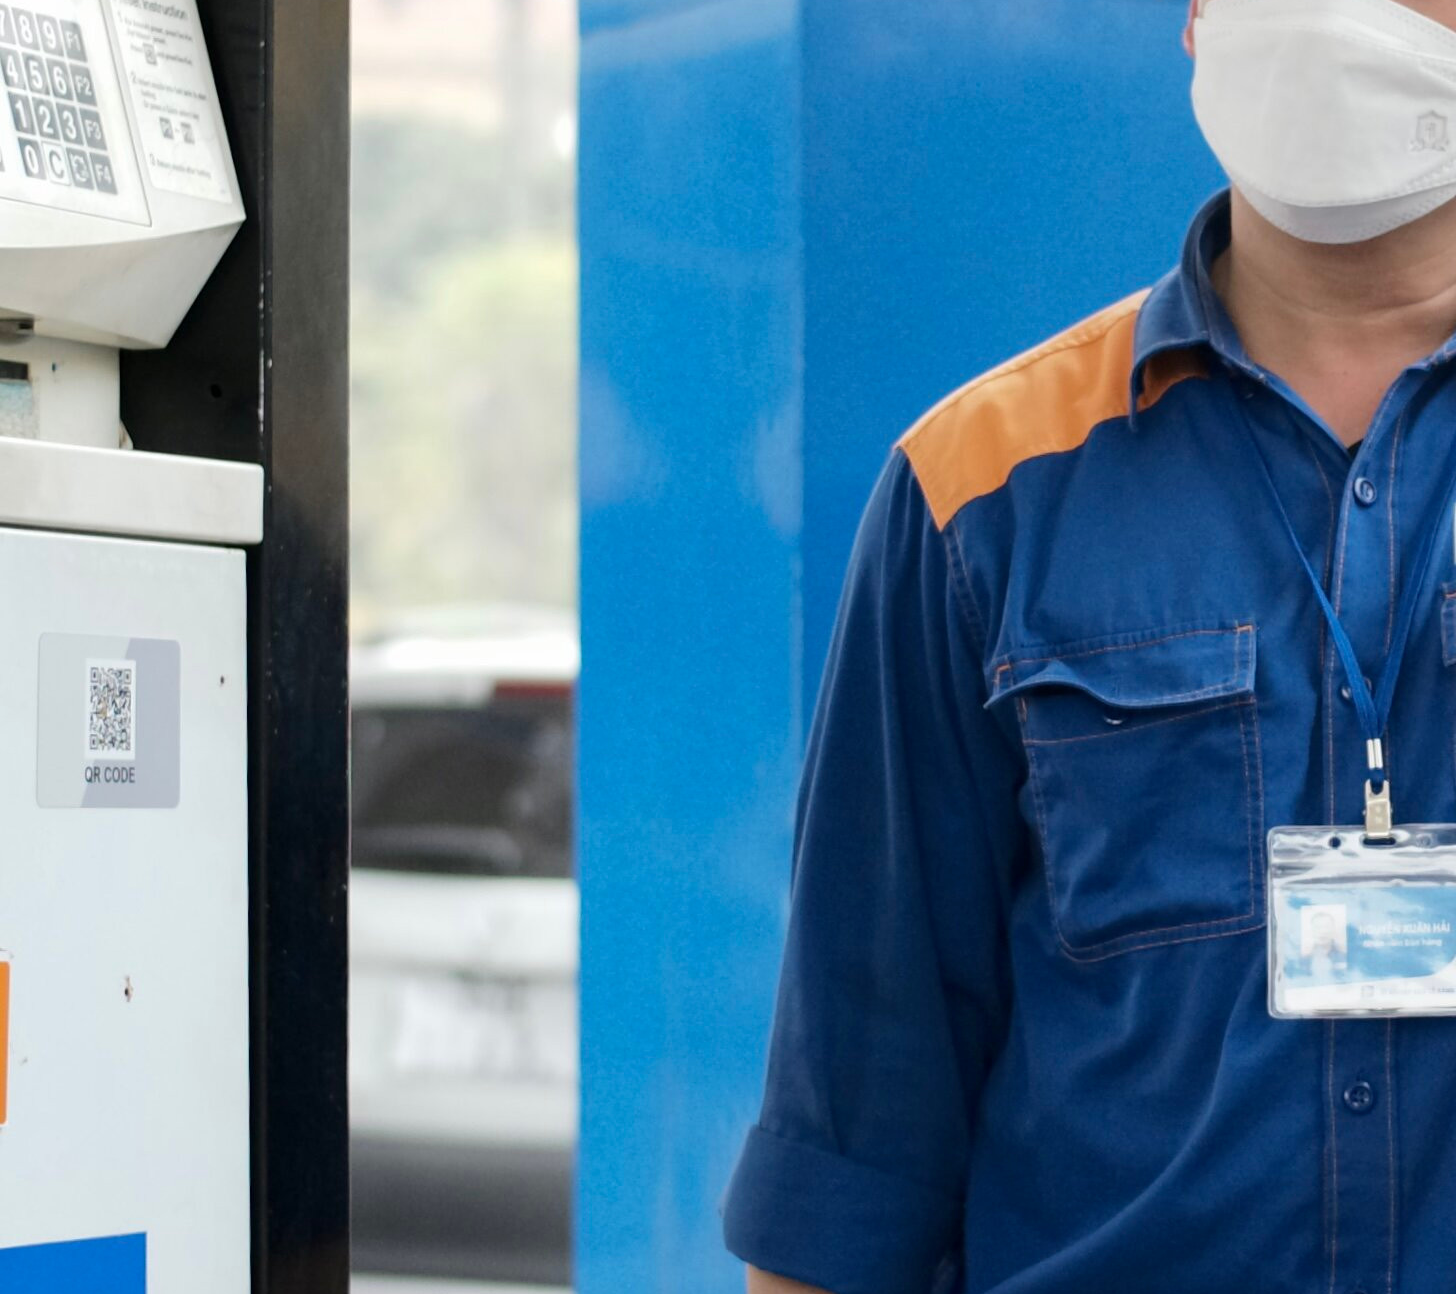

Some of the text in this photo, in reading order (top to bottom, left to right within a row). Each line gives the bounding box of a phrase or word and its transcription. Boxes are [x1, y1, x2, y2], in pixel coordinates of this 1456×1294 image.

[18, 14, 33, 45] 8
[42, 20, 57, 50] 9
[65, 31, 82, 52] F1
[5, 55, 93, 97] 4 5 6 F2
[15, 99, 102, 141] 1 2 3 F3
[24, 144, 113, 185] 0 C F4
[84, 766, 136, 784] QR CODE
